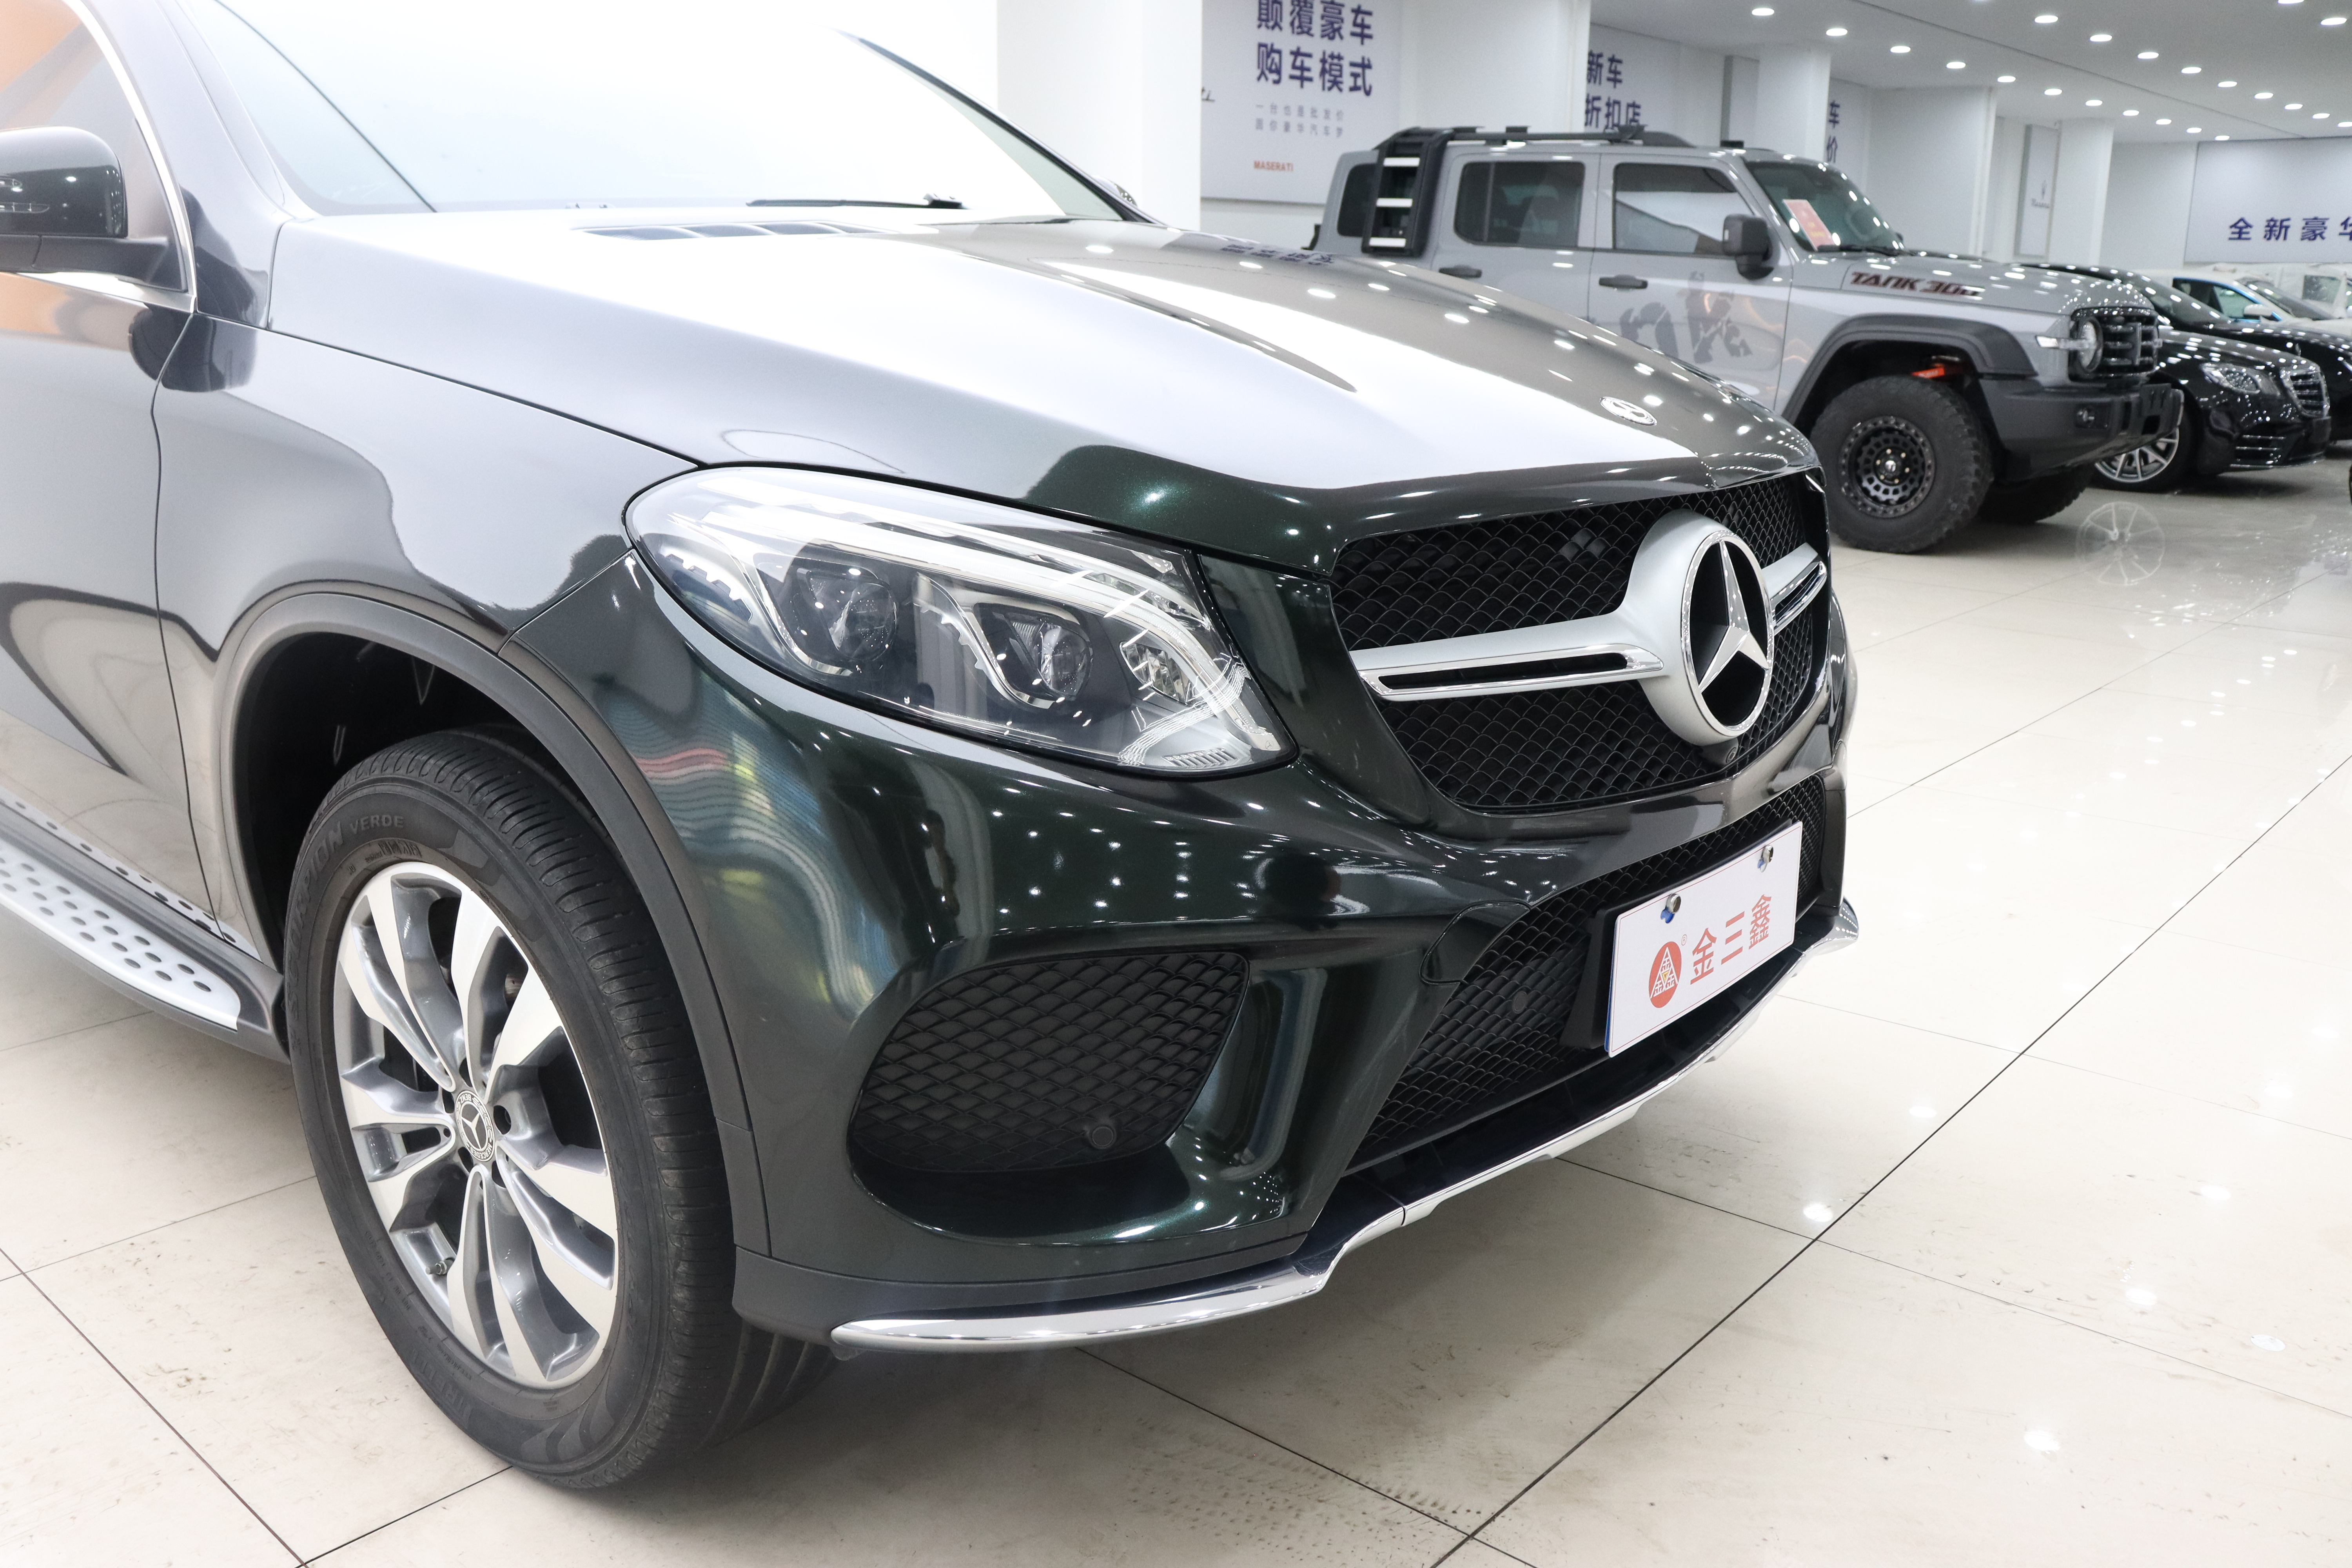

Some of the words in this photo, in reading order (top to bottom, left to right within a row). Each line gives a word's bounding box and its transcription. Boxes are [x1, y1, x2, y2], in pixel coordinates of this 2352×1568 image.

[1257, 0, 1373, 45] 颠覆豪车
[1257, 43, 1372, 96] 购车模式
[1584, 93, 1641, 131] 折扣店
[1254, 160, 1293, 172] MASERATI
[349, 814, 404, 835] VERDE
[1690, 894, 1772, 985] 金三鑫
[459, 1093, 472, 1103] BENZ
[470, 1142, 493, 1160] MERCEDES
